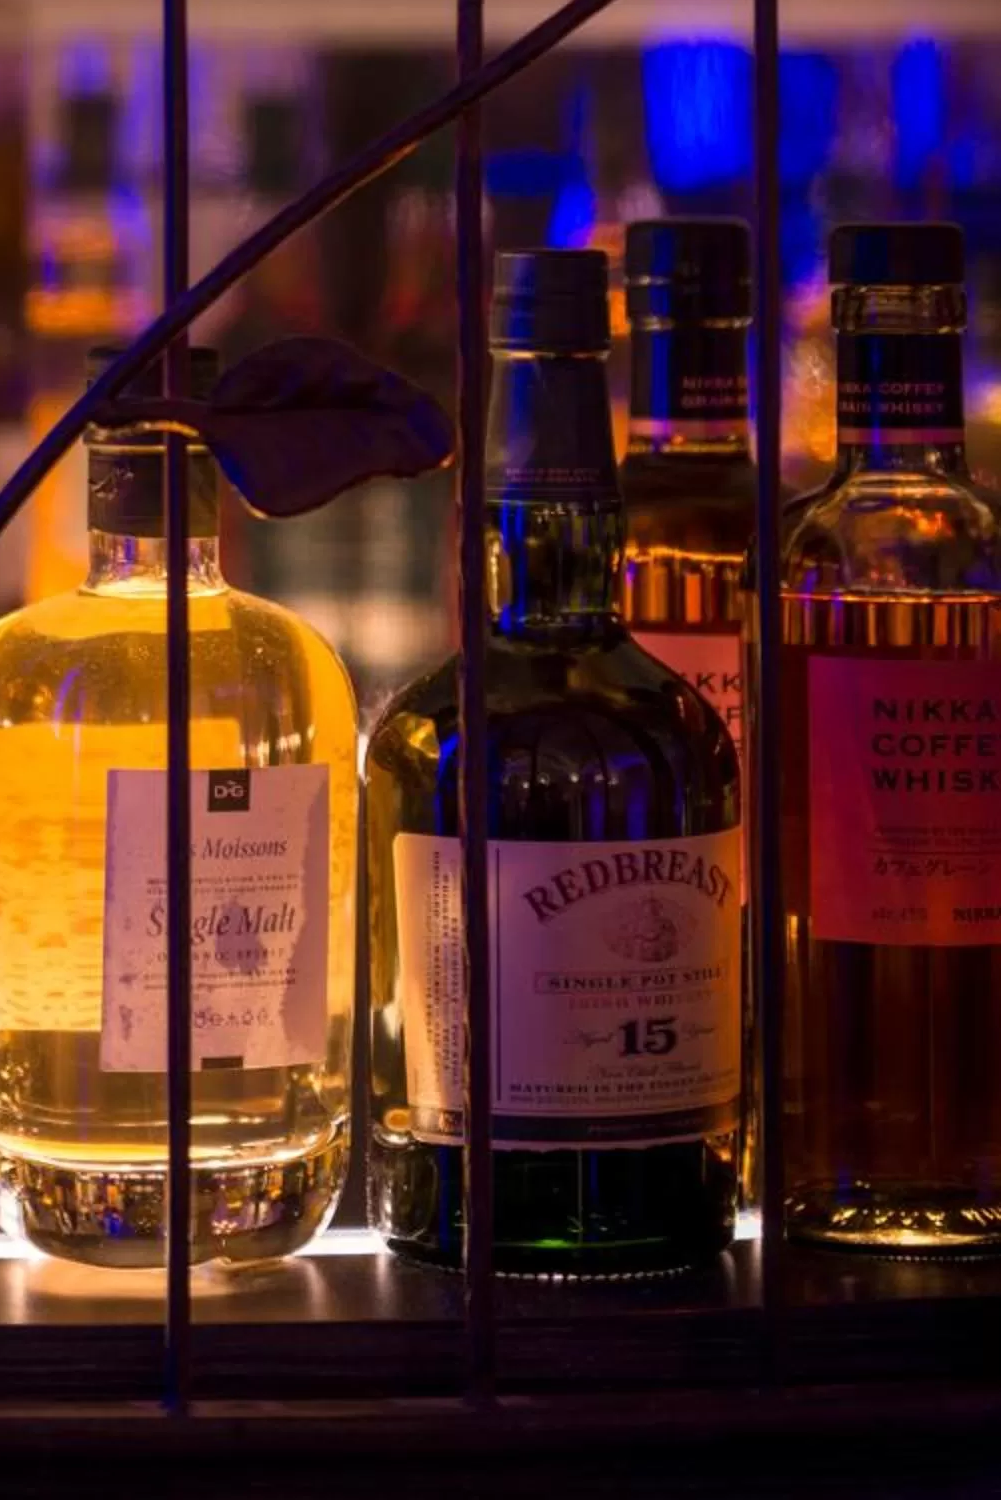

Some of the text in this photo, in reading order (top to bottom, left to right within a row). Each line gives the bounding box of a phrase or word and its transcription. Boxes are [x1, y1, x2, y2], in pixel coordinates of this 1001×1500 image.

[872, 698, 996, 724] NIKKA
[871, 732, 1001, 757] COFFE
[203, 835, 287, 860] Moissons
[147, 900, 296, 946] Sgle Malt
[548, 974, 633, 992] SINGLE
[639, 974, 677, 988] POT
[618, 1016, 680, 1059] 15
